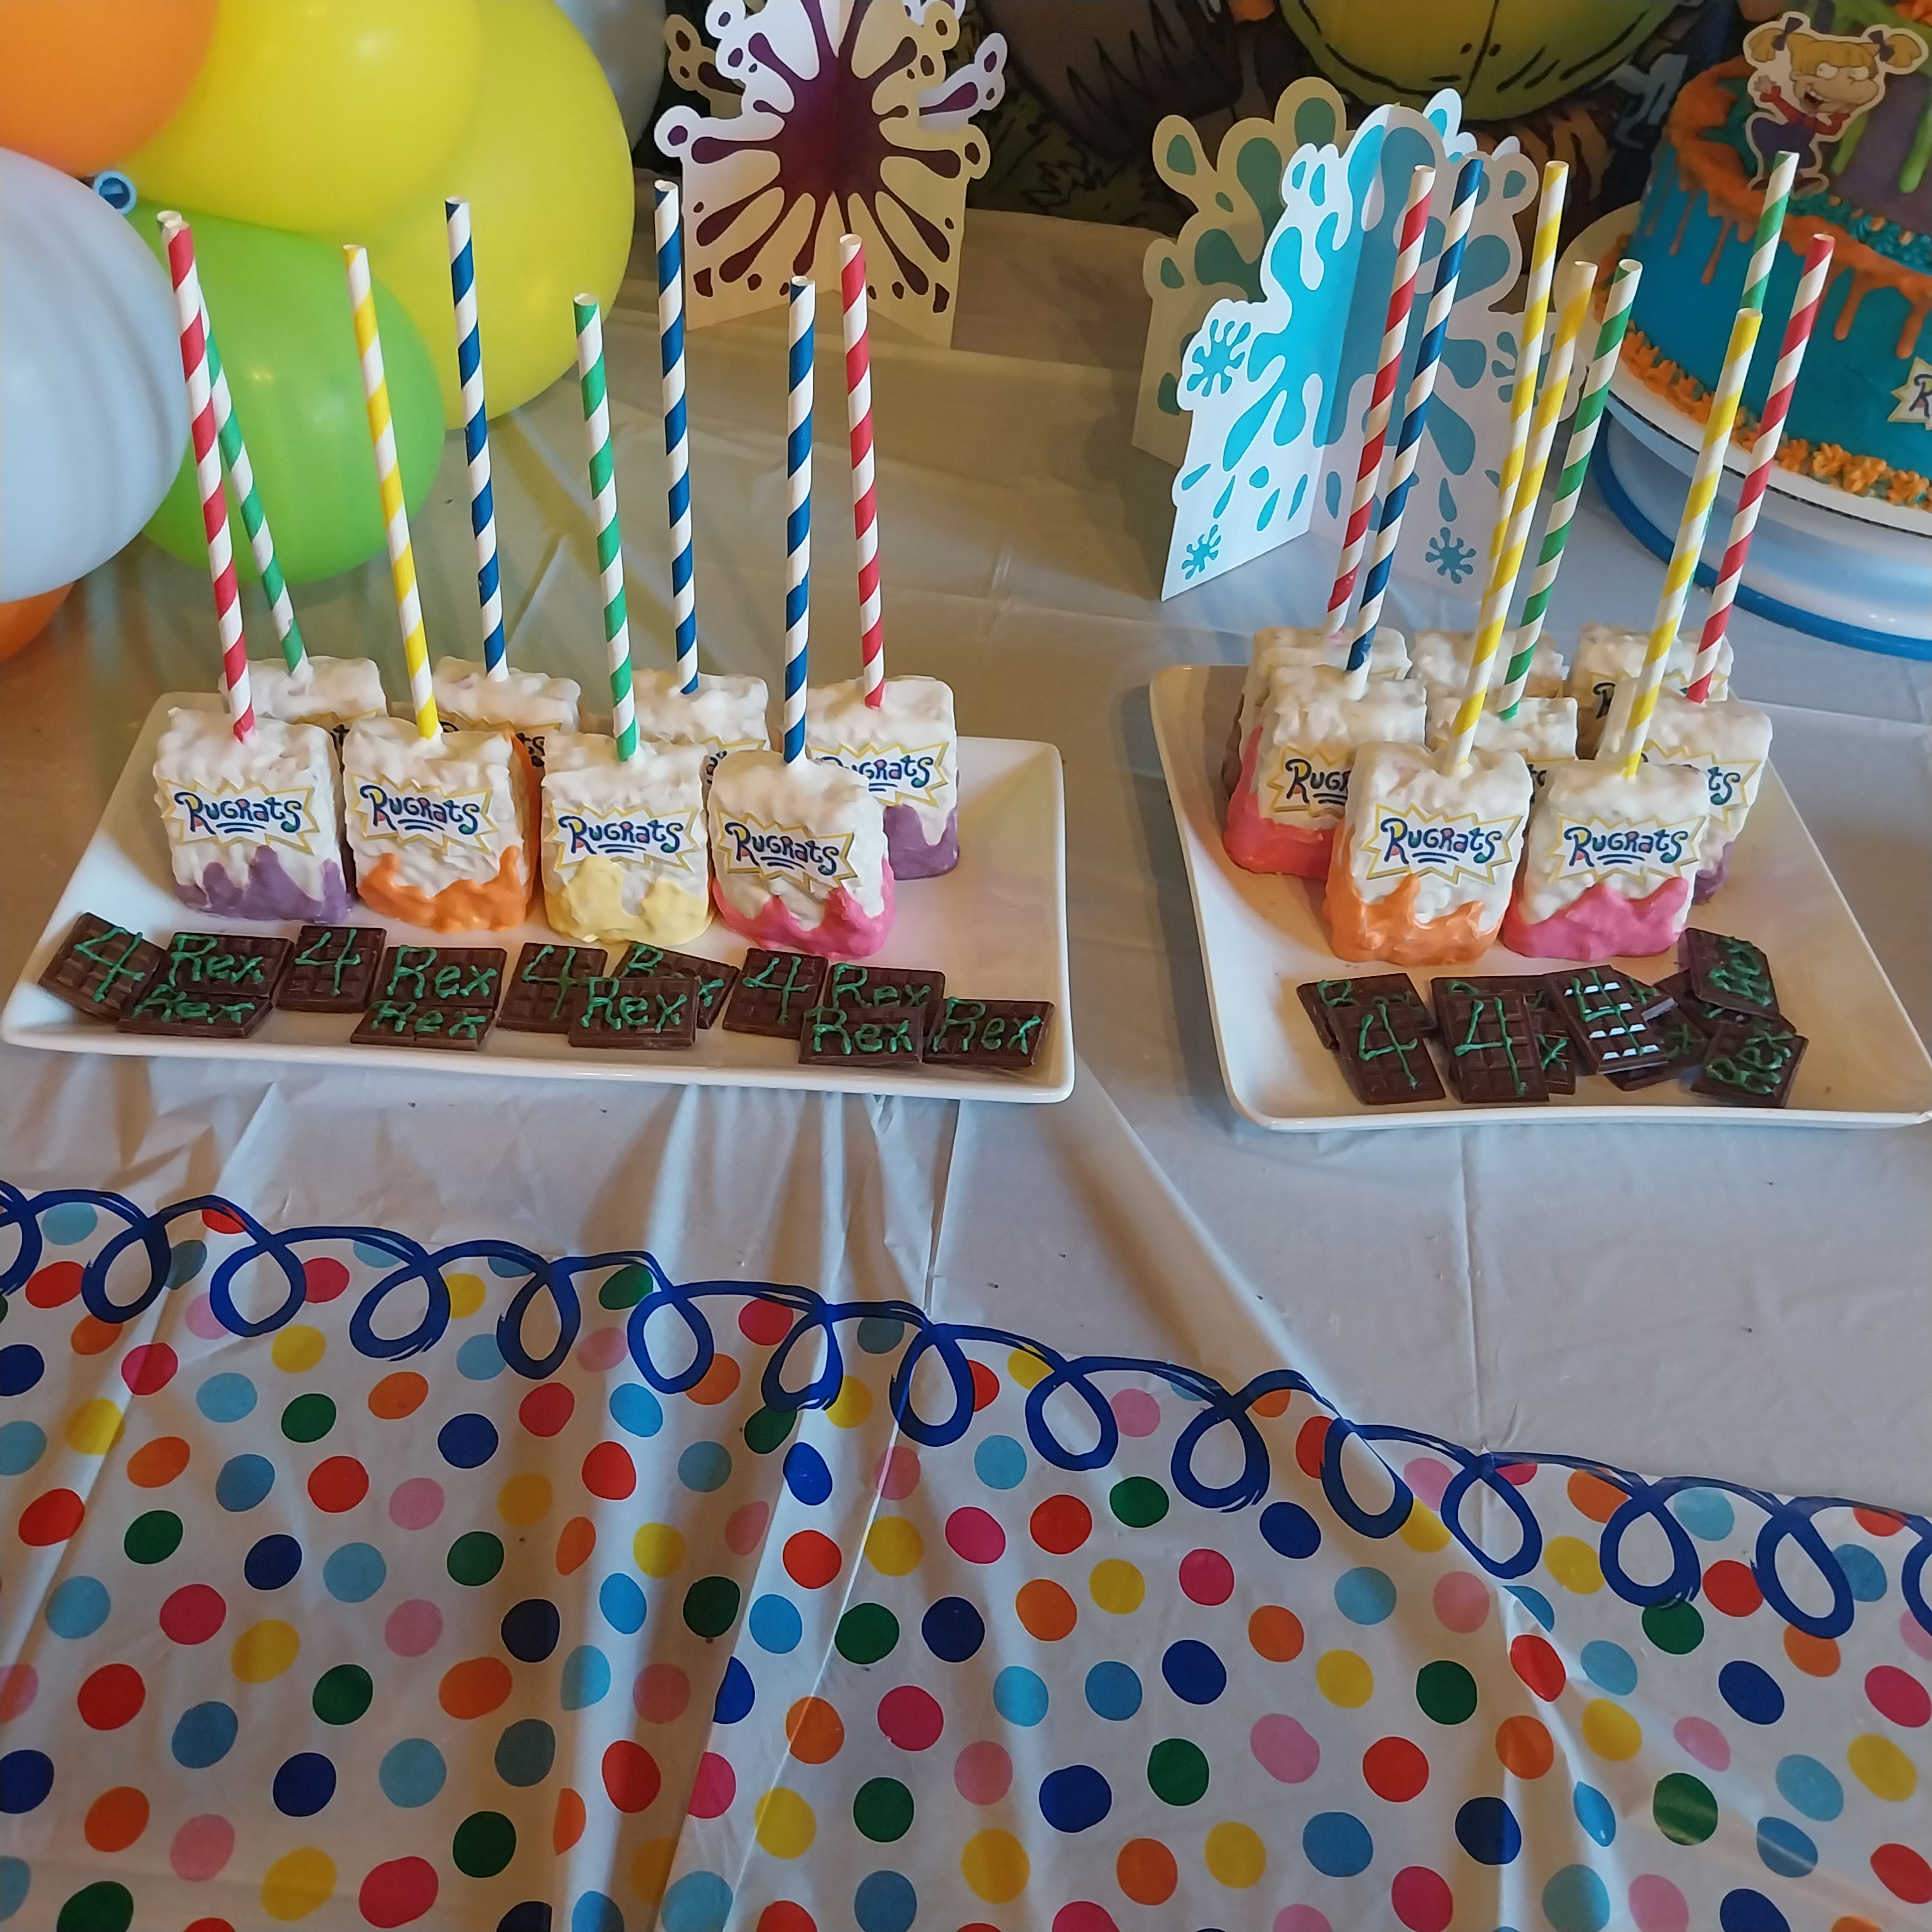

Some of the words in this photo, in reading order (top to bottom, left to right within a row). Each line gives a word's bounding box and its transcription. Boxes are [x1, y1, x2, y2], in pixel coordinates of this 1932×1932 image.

[74, 926, 145, 1002] 4
[168, 934, 264, 987] Rex
[295, 929, 362, 997] 4
[387, 945, 498, 999] Rex
[522, 945, 583, 1022] 4
[743, 957, 812, 1027] 4
[831, 962, 931, 1010] Rex
[371, 1000, 486, 1039] Rex
[580, 976, 687, 1033] Rex
[804, 1006, 913, 1055] Rex
[933, 996, 1042, 1054] Rex
[1570, 968, 1645, 1056] 4
[1358, 1003, 1419, 1090] 4
[1455, 996, 1527, 1097] 4
